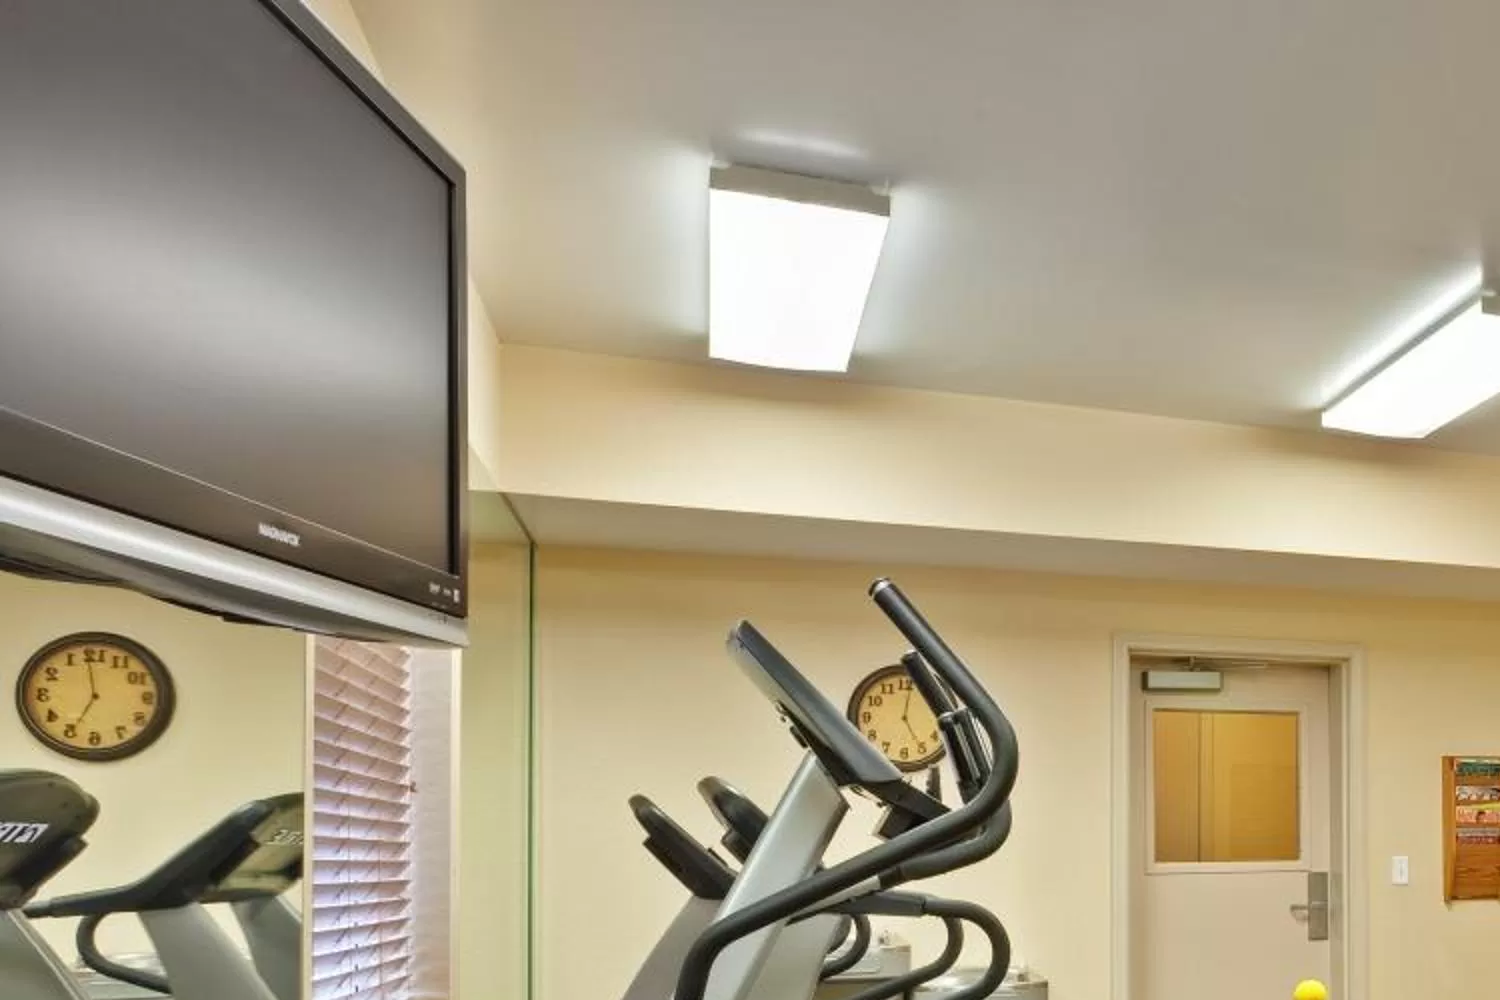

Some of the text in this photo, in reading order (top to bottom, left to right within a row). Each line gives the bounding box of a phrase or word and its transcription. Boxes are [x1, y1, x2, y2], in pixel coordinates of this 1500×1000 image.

[880, 683, 893, 694] 11
[868, 695, 882, 706] 10
[863, 711, 871, 724] 9
[882, 741, 890, 753] 7
[900, 747, 908, 759] 6
[917, 742, 927, 754] 5
